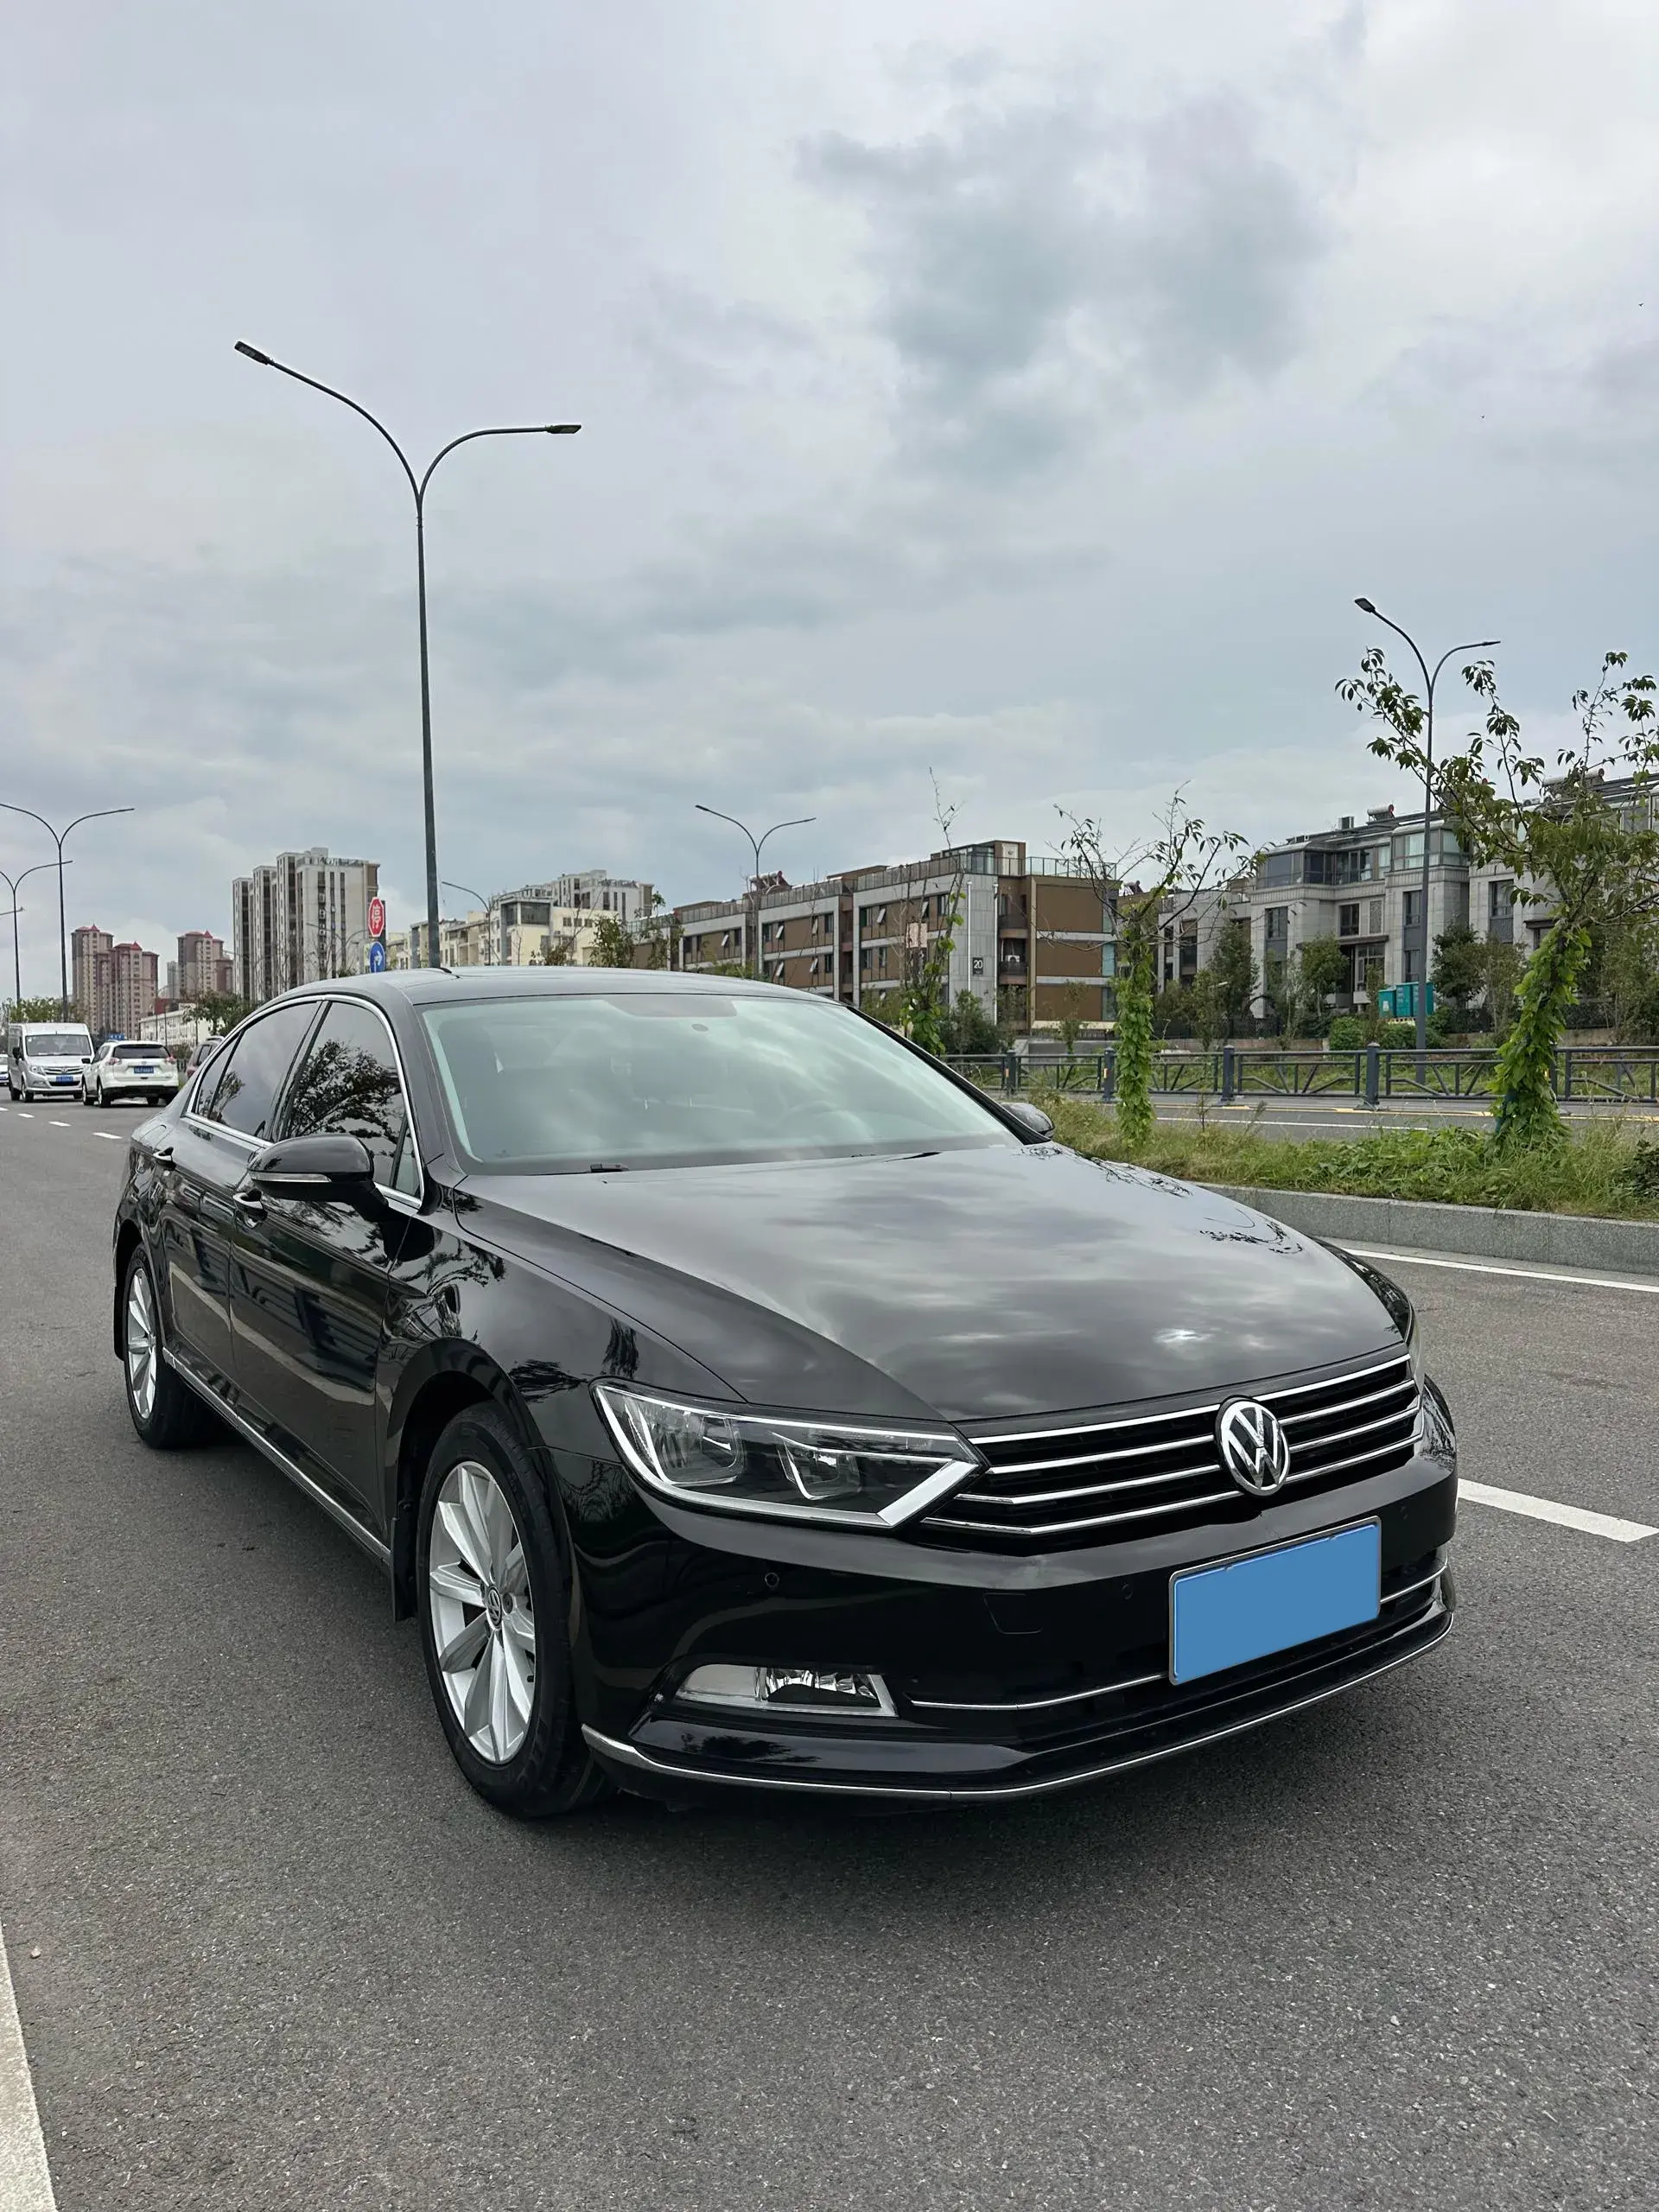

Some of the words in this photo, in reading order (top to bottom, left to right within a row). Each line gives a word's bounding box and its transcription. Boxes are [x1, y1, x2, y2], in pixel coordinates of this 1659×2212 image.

[372, 904, 382, 929] 停
[973, 959, 983, 969] 20
[1224, 1402, 1287, 1491] VW
